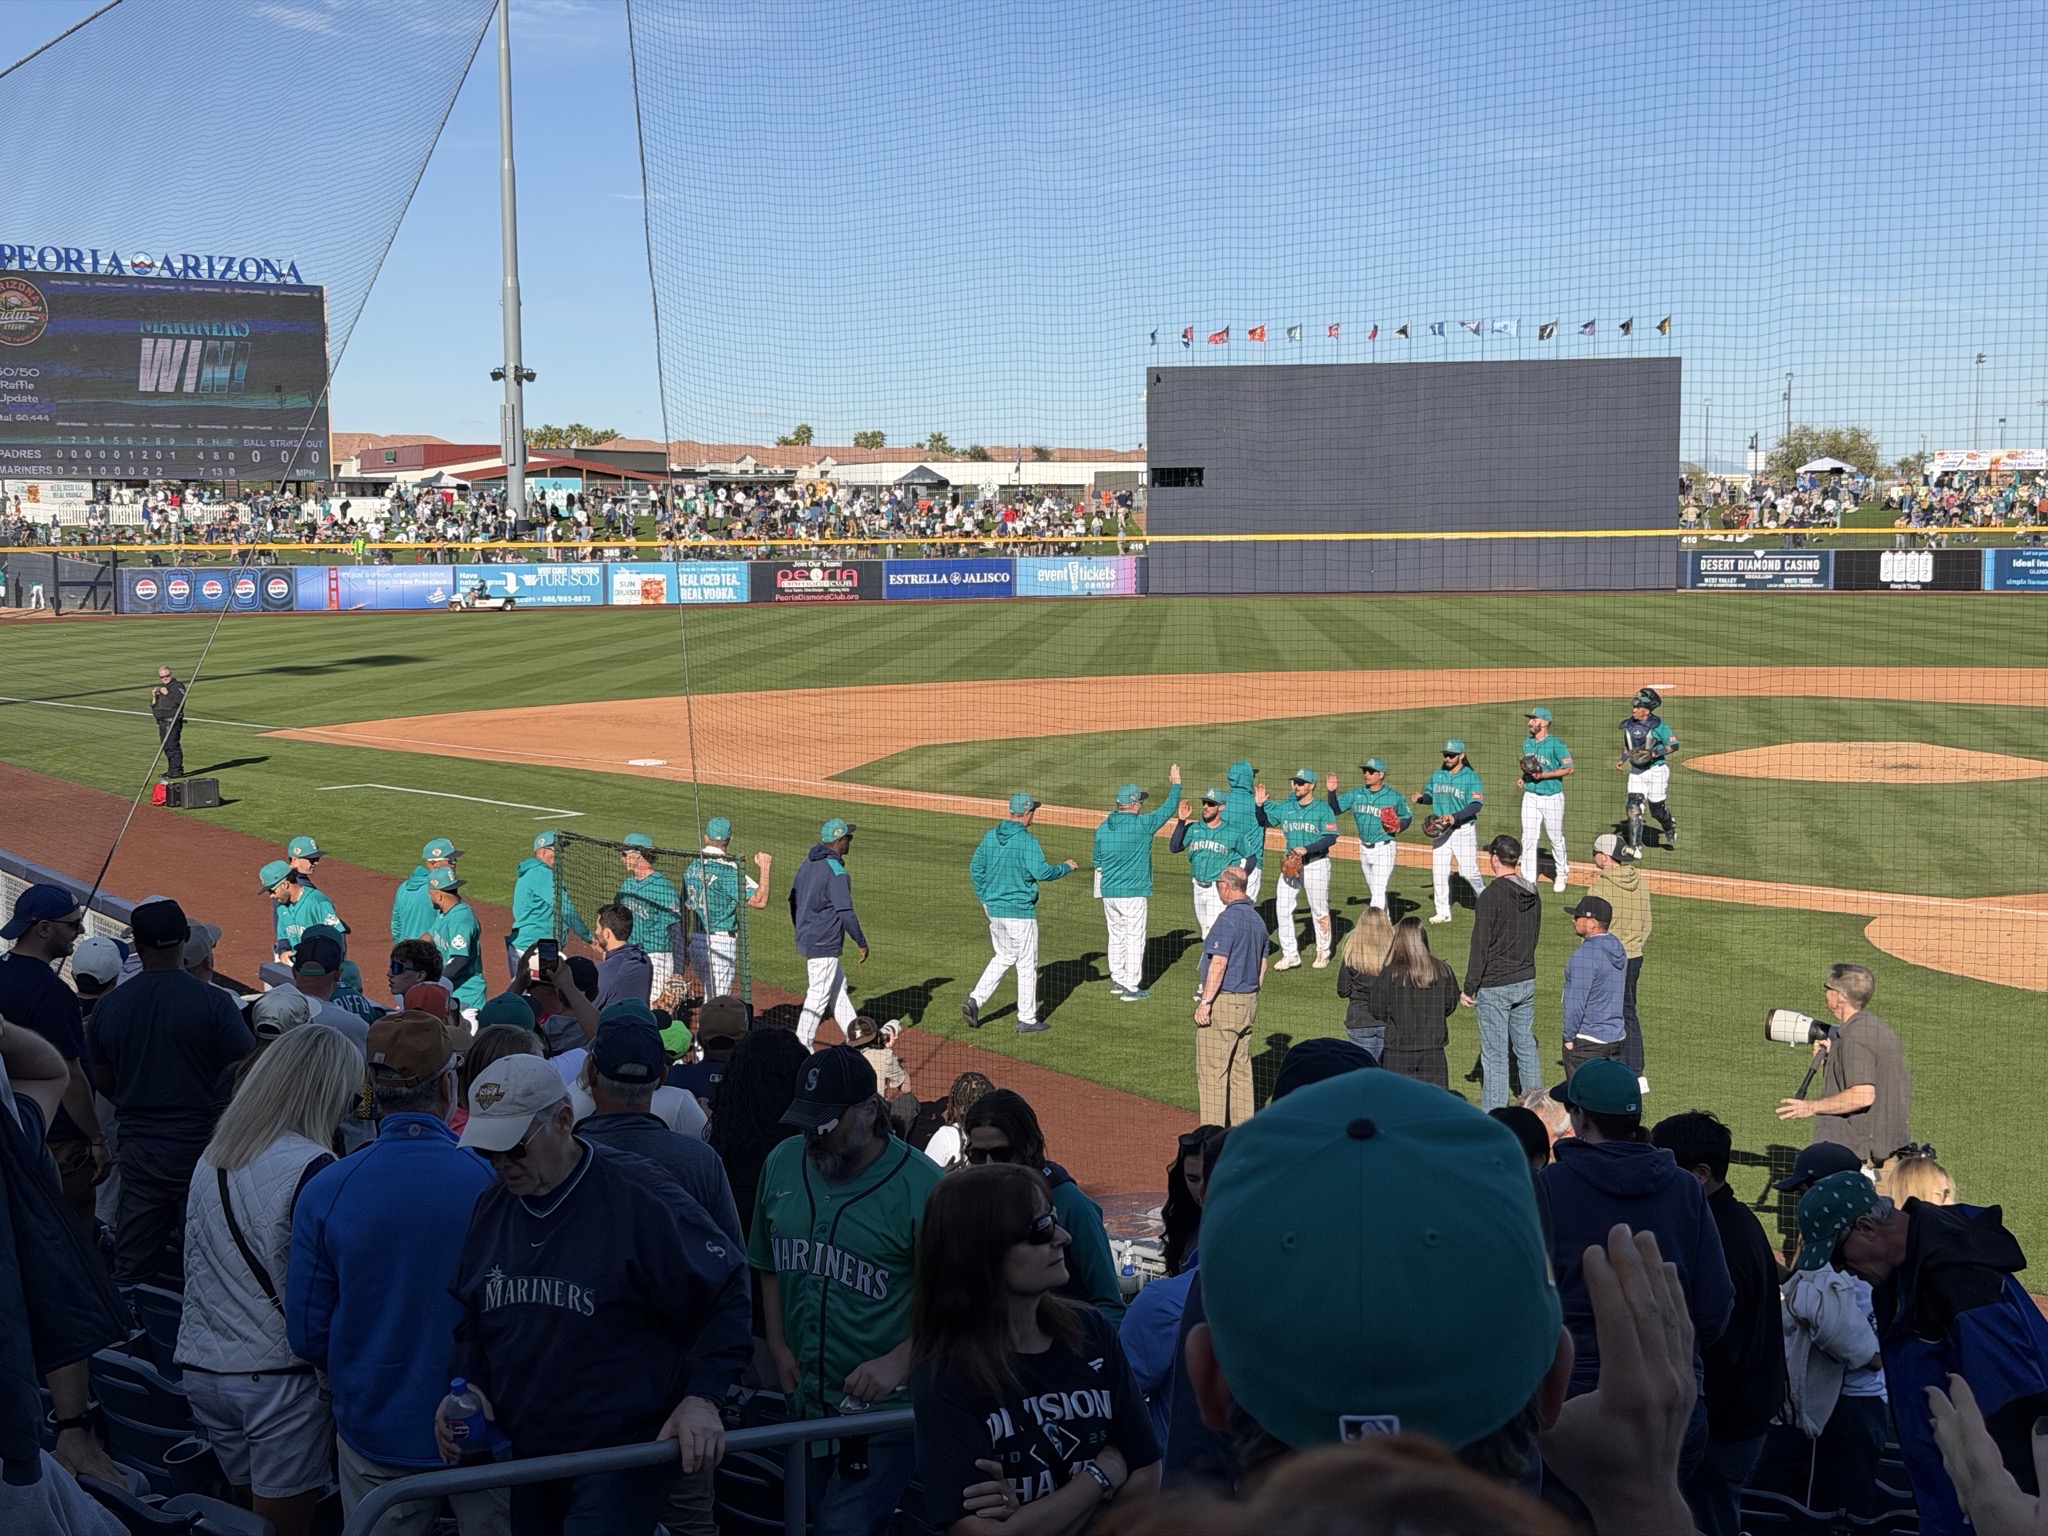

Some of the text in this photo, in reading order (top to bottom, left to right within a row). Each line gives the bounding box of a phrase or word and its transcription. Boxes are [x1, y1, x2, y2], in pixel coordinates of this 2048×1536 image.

[0, 244, 304, 284] PEORIA ARIZONA
[0, 380, 35, 390] Raffle
[197, 438, 204, 446] R
[56, 450, 62, 458] 0
[71, 450, 78, 458] 0
[85, 450, 92, 459] 0
[100, 450, 106, 459] 0
[114, 450, 120, 459] 0
[129, 451, 134, 460] 1
[142, 451, 148, 460] 2
[156, 451, 162, 460] 0
[170, 451, 176, 460] 1
[198, 452, 204, 460] 4
[213, 452, 220, 460] 8
[228, 452, 235, 460] 0
[252, 450, 320, 464] 0 0 0
[0, 465, 316, 477] MARINERS 0 2 1 0 0 0 2 2 7 13 0 MPH
[1700, 559, 1820, 571] DESERT DIAMOND CASINO
[2012, 558, 2036, 568] Ideal
[539, 574, 600, 586] TURF SOD
[700, 574, 720, 586] ICED
[721, 574, 741, 586] TEA.
[889, 572, 1010, 585] ESTRELLA JALISCO
[1038, 567, 1068, 582] event
[1079, 566, 1116, 581] tickets
[681, 588, 738, 600] REAL VODKA.
[776, 594, 859, 602] PeoriaDiamondClub.org
[481, 1267, 596, 1317] MARINERS
